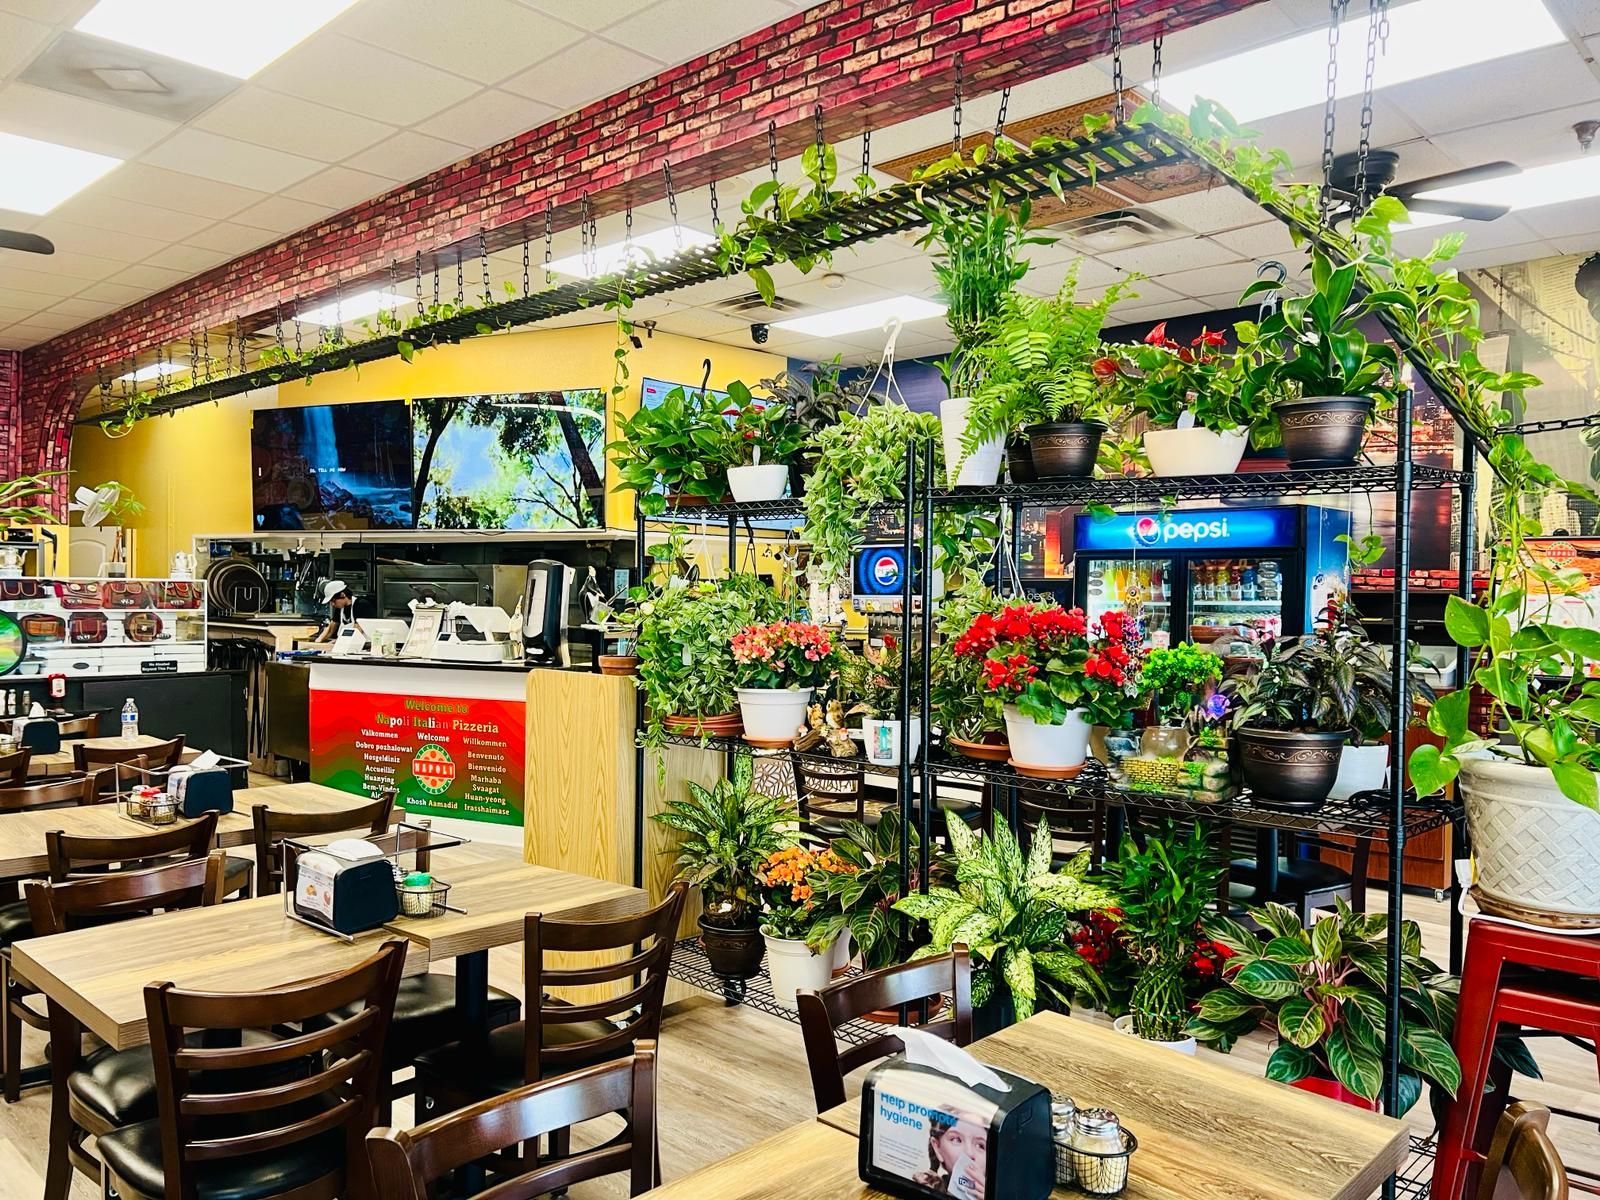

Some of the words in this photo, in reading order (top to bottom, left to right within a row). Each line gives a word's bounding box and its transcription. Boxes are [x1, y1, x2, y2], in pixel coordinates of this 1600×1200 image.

[1163, 517, 1229, 544] pepsi
[405, 699, 453, 713] Welcome
[456, 704, 468, 714] to
[376, 712, 410, 728] Napoli
[413, 716, 449, 730] Italian
[452, 719, 499, 734] Pizzeria
[417, 732, 450, 742] Welcome
[462, 736, 507, 748] Willkommen
[355, 741, 374, 749] Dobro
[467, 750, 504, 761] Benvenuto
[414, 762, 452, 776] NAPOLI
[468, 762, 507, 773] Bienvenido
[364, 773, 395, 785] Huanying
[470, 774, 502, 785] Marhaba
[472, 784, 500, 795] Svaagat
[406, 796, 426, 806] Khosh
[428, 800, 458, 810] Aamadid
[464, 792, 506, 806] Huan-yeong
[464, 803, 510, 816] Irasshaimase
[880, 1092, 906, 1110] Help
[880, 1104, 923, 1130] hygiene
